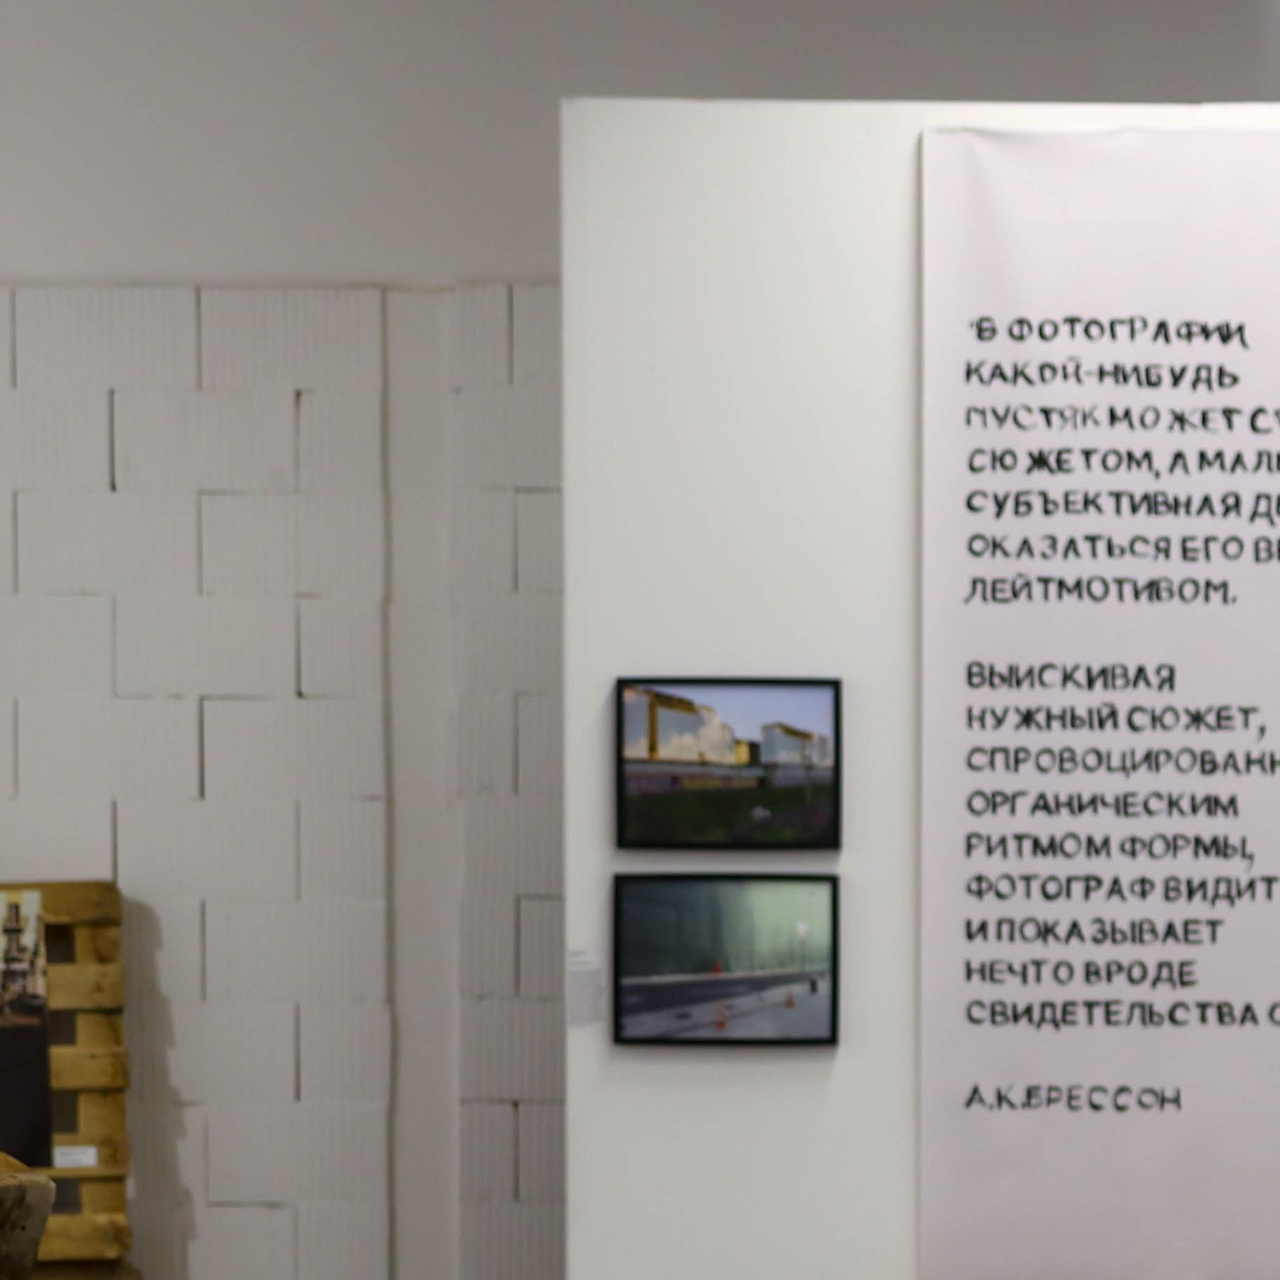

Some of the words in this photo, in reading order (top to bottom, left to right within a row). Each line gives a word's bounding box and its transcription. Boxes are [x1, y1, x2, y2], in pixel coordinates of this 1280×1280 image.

[1005, 314, 1250, 351] ФОТОГРАФИИ
[963, 356, 1241, 394] КАКОЙ-НИБУДЬ
[964, 404, 1101, 432] ПУСТЯК
[1106, 404, 1244, 434] МОЖЕТ
[966, 446, 1162, 481] СЮЖЕТОМ,
[1167, 448, 1191, 476] А
[963, 488, 1243, 522] СУБЪЕКТИВНАЯ
[966, 532, 1172, 562] ОКАЗАТЬСЯ
[1179, 534, 1246, 564] ЕГО
[962, 572, 1238, 606] ЛЕЙТМОТИВОМ.
[965, 660, 1177, 694] ВЫИСКИВАЯ
[965, 702, 1121, 733] НУЖНЫЙ
[1124, 704, 1267, 742] СЮЖЕТ,
[965, 788, 1240, 820] ОРГАНИЧЕСКИМ
[964, 831, 1112, 861] РИТМОМ
[1117, 832, 1256, 871] ФОРМЫ,
[964, 872, 1156, 903] ФОТОГРАФ
[1161, 874, 1280, 909] ВИДИТ
[964, 917, 990, 943] И
[994, 916, 1225, 947] ПОКАЗЫВАЕТ
[963, 958, 1075, 987] НЕЧТО
[1082, 959, 1199, 991] ВРОДЕ
[964, 998, 1260, 1033] СВИДЕТЕЛЬСТВА
